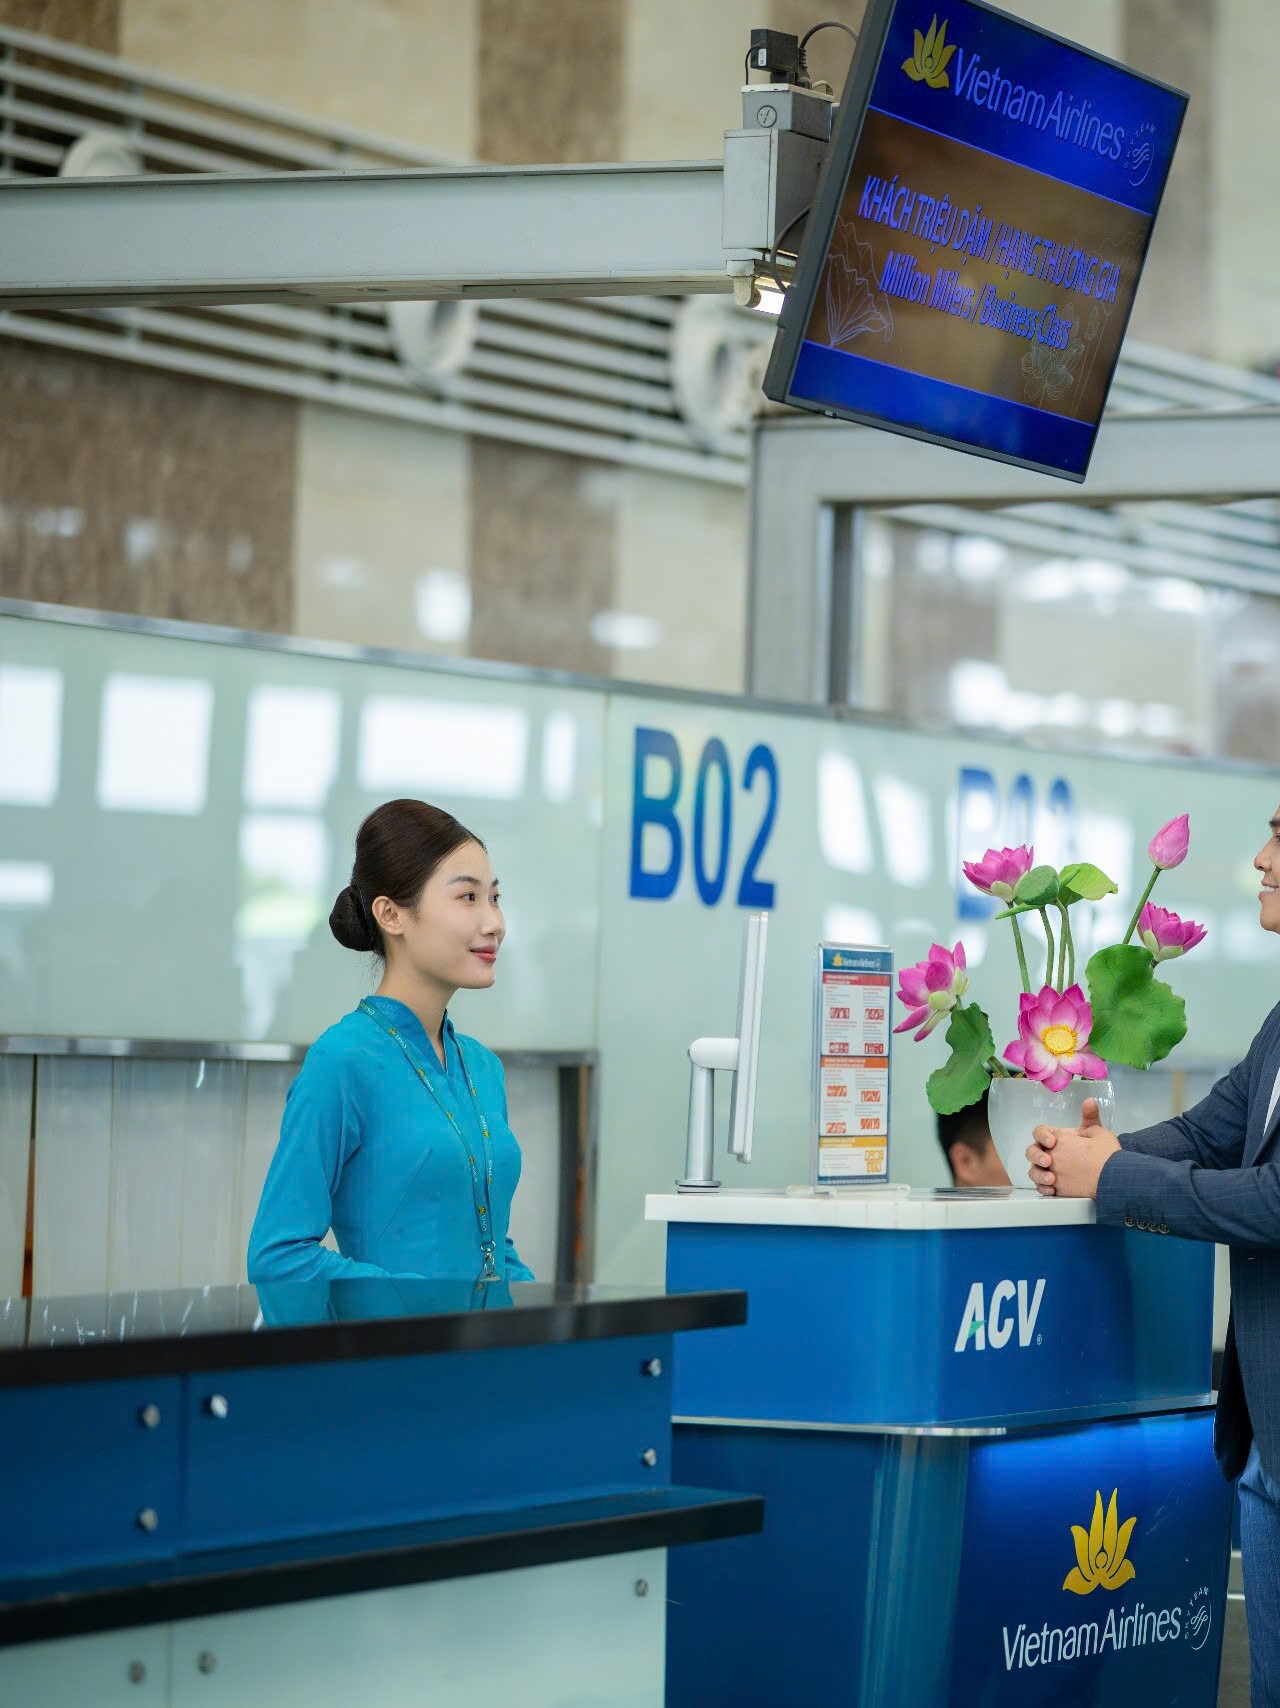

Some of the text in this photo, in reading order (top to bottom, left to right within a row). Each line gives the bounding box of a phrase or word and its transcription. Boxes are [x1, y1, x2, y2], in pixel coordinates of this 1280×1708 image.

[955, 47, 1126, 160] Vietnam Airlines
[857, 174, 918, 233] KHÁCH
[911, 192, 959, 255] TRIỆU
[1094, 260, 1121, 304] GIA
[878, 250, 931, 305] Million
[979, 283, 1040, 340] Business
[1037, 303, 1073, 350] Class
[630, 726, 780, 909] B02
[1002, 1602, 1182, 1671] Vietnam Airlines
